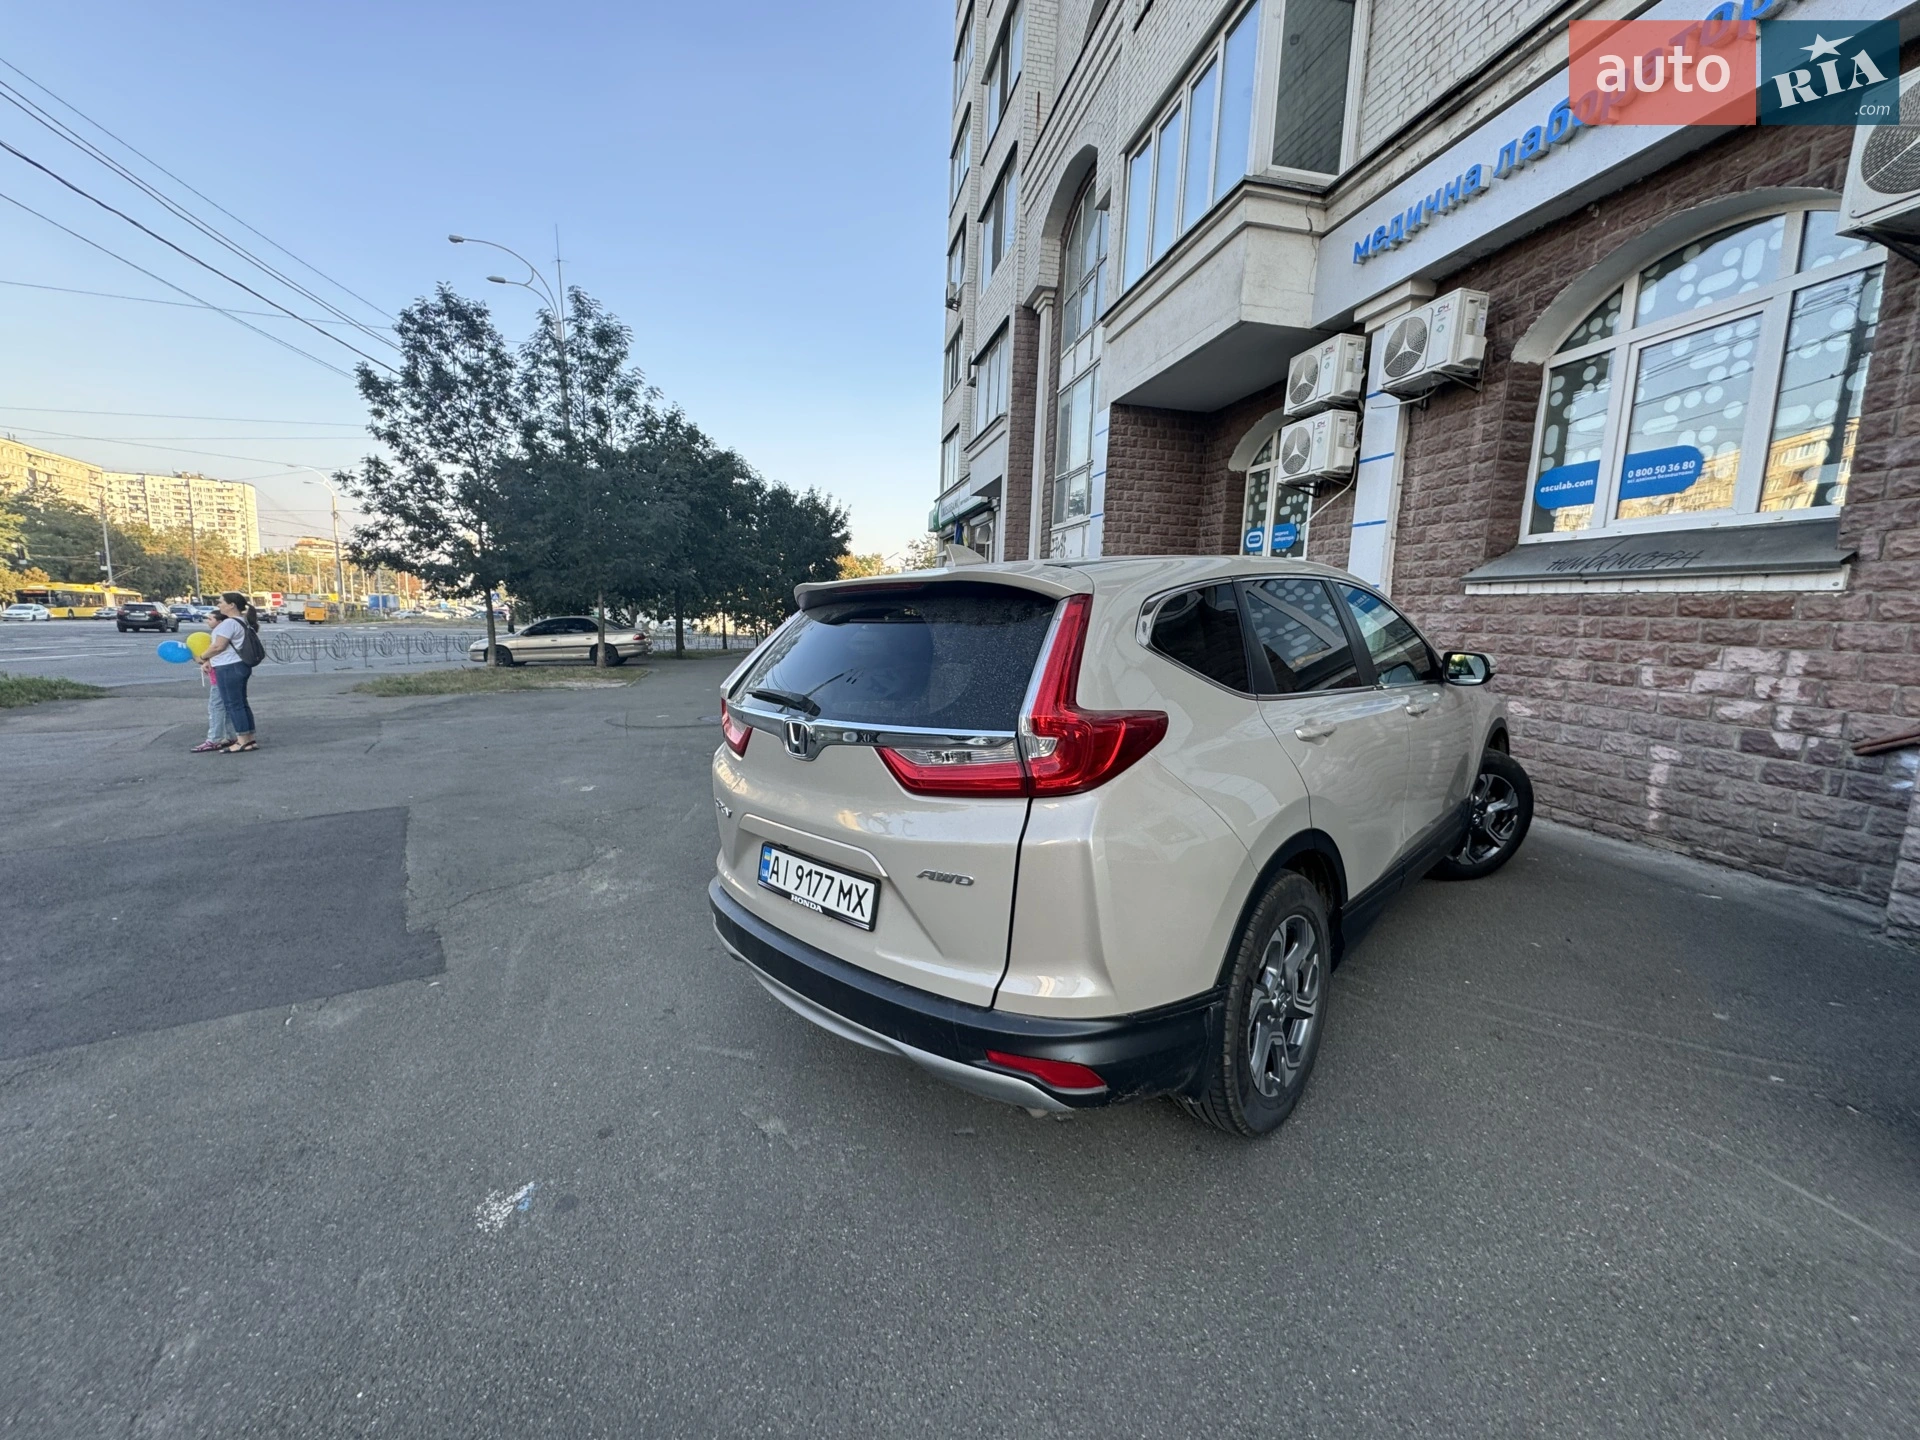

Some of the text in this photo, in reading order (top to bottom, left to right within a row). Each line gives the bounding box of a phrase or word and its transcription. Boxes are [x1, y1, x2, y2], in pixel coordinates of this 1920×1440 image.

[1353, 163, 1484, 265] медична
[1628, 460, 1695, 478] 0 800 50 36 80
[1540, 478, 1594, 493] esculab.com
[769, 855, 869, 917] AI 9177 MX
[916, 868, 975, 886] AWD
[790, 893, 823, 914] HONDA
